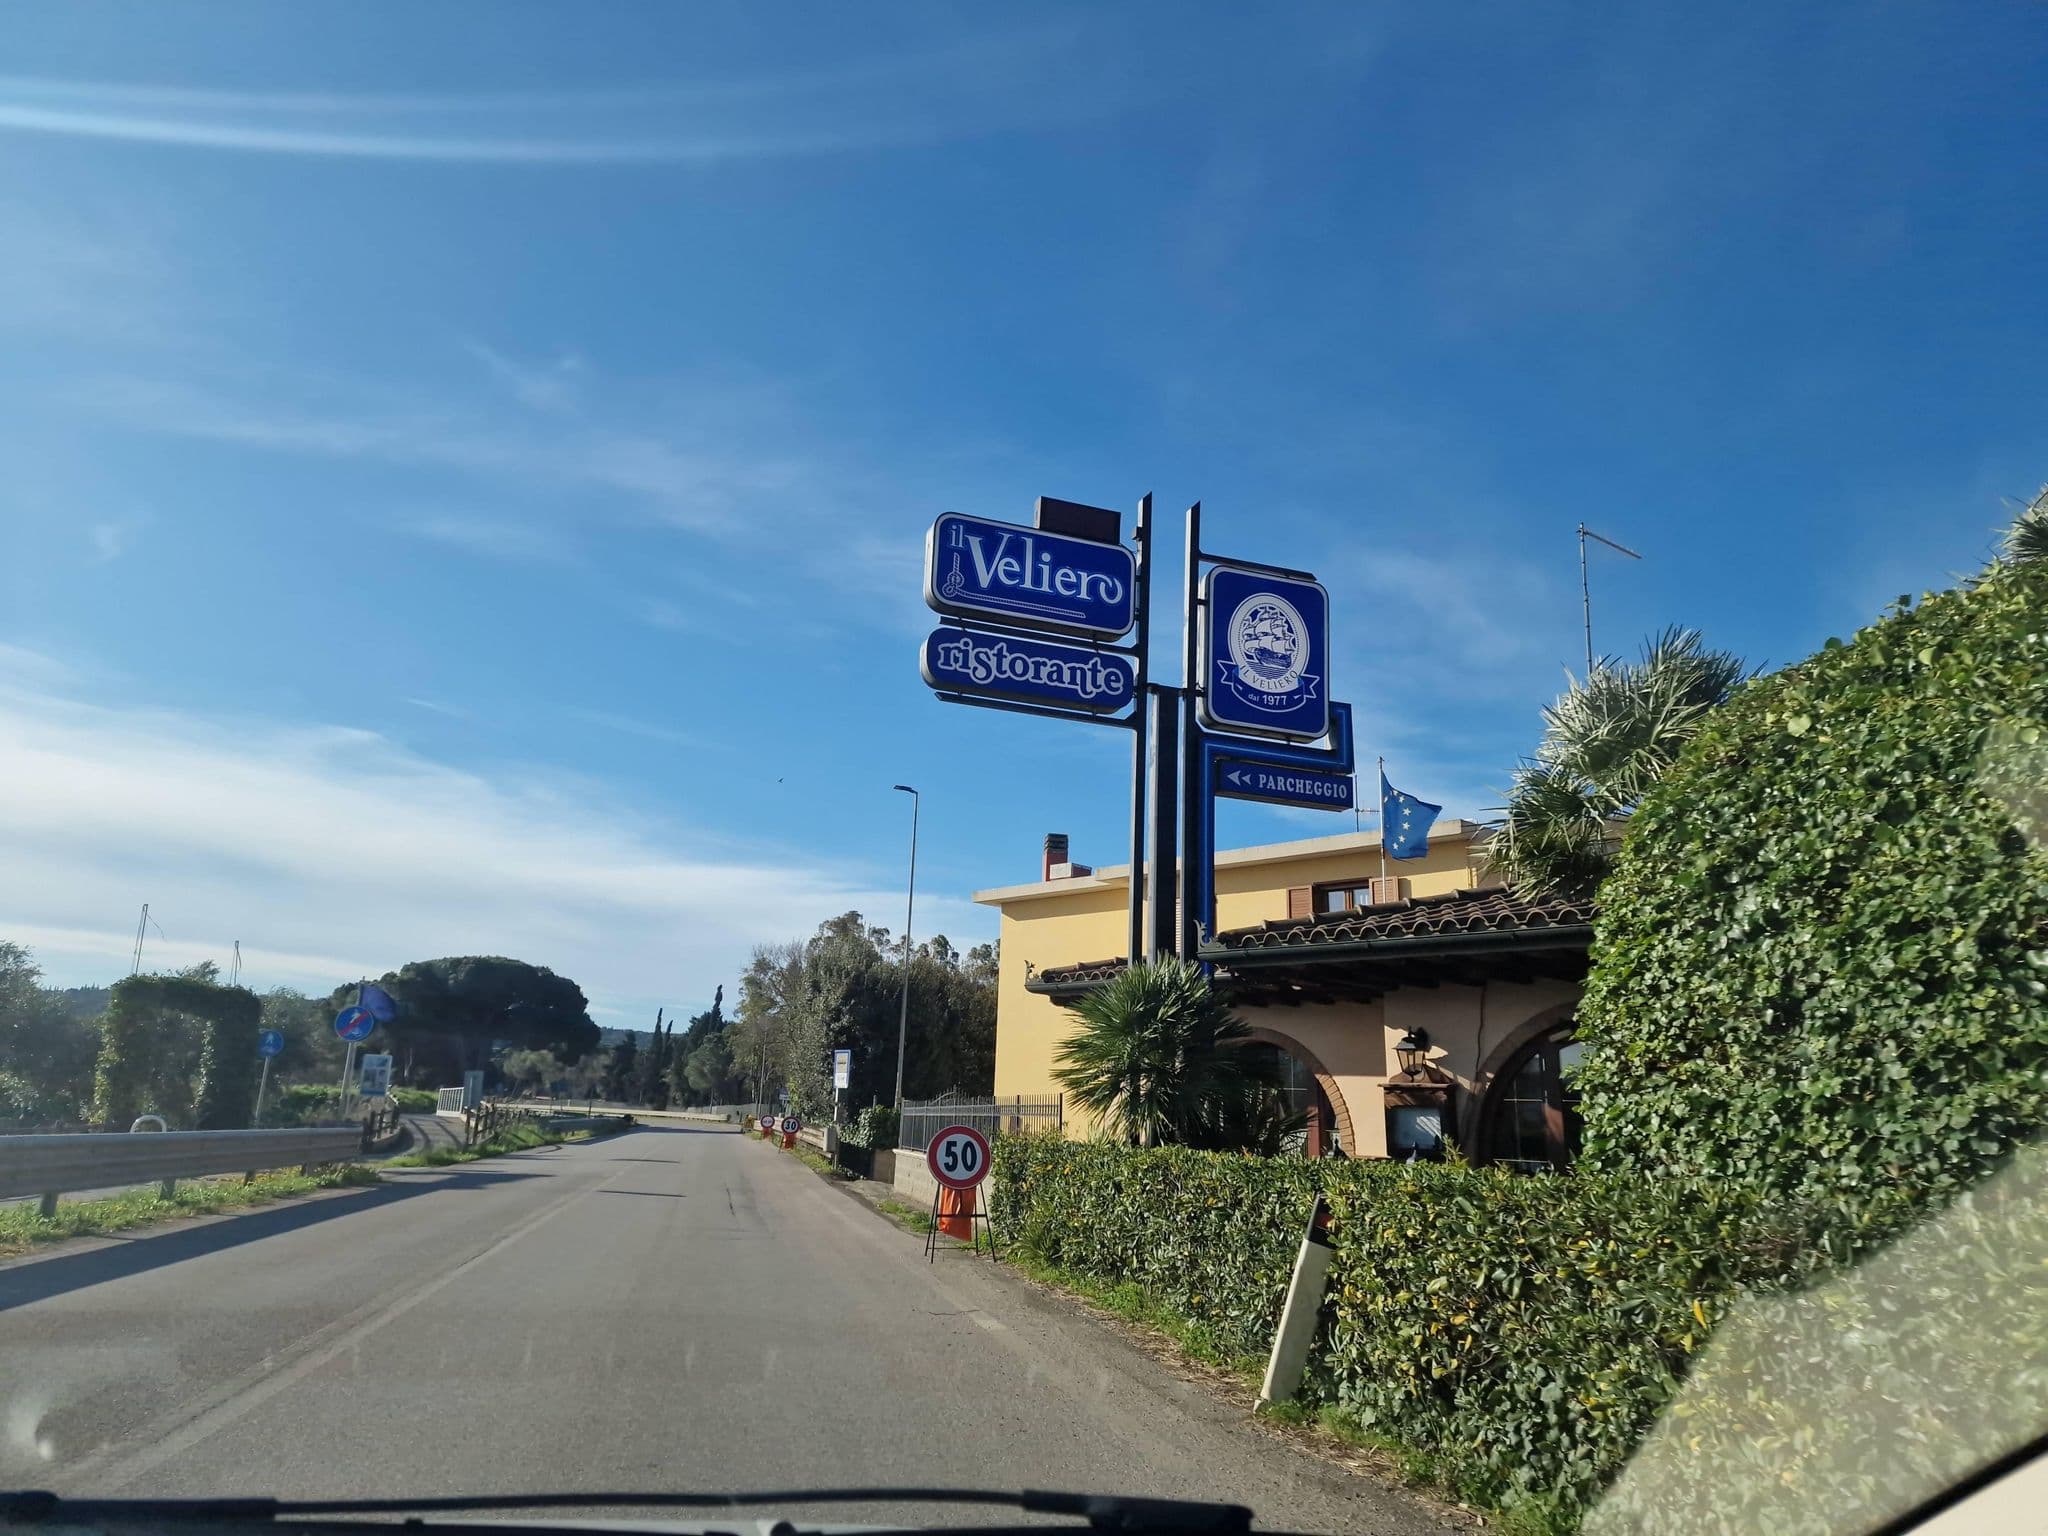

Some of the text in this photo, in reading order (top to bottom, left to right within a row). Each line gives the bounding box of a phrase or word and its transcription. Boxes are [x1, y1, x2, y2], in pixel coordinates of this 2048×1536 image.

[950, 524, 965, 548] il
[965, 532, 1123, 604] Veliero
[937, 638, 1124, 698] ristorante
[1240, 664, 1298, 690] IL VELIERO
[1248, 693, 1287, 706] dal 1977
[1258, 773, 1347, 799] PARCHEGGIO
[785, 1120, 797, 1131] 30
[944, 1140, 977, 1172] 50
